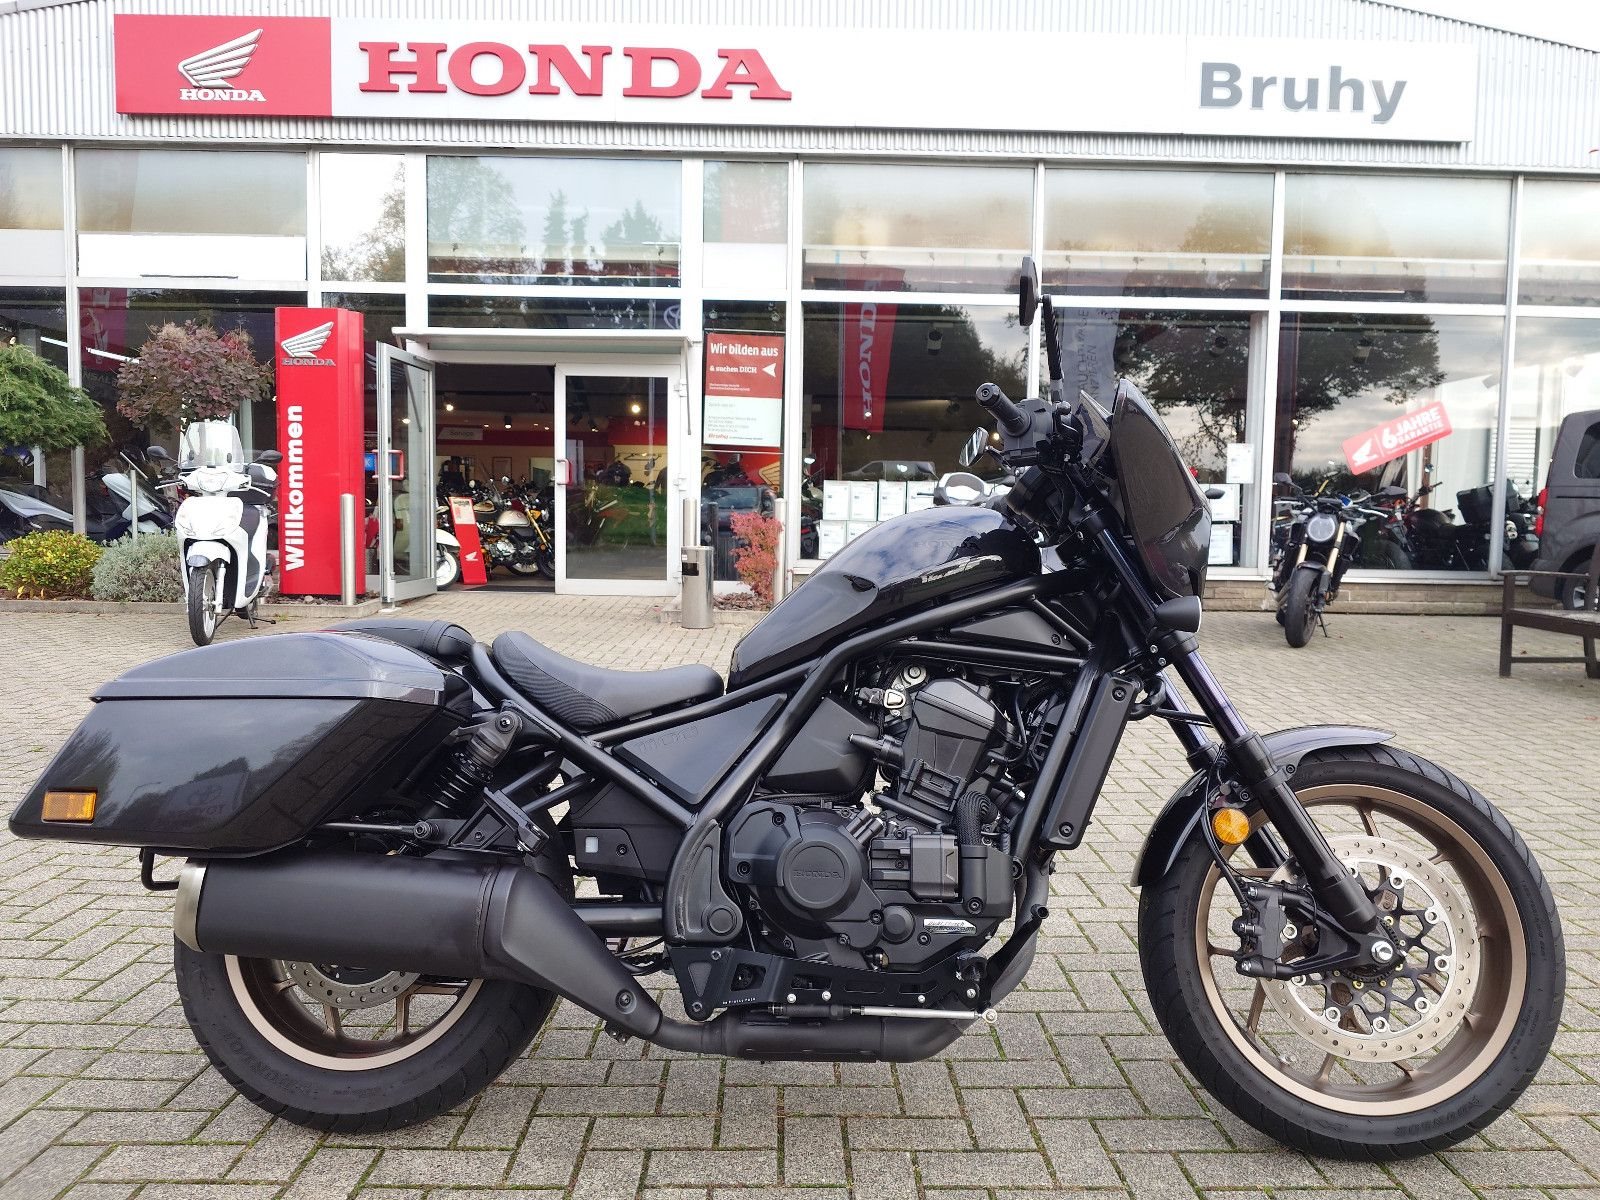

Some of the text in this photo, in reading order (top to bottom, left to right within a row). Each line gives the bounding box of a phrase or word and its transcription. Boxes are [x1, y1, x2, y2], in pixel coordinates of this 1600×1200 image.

[358, 41, 792, 101] HONDA
[180, 88, 267, 102] HONDA
[1199, 62, 1407, 125] Bruhy
[281, 358, 337, 367] HONDA
[710, 342, 779, 357] Wir bilden aus
[1382, 406, 1441, 449] 6 JAHRE
[1397, 421, 1444, 445] GARANTIE
[285, 405, 304, 571] Willkommen
